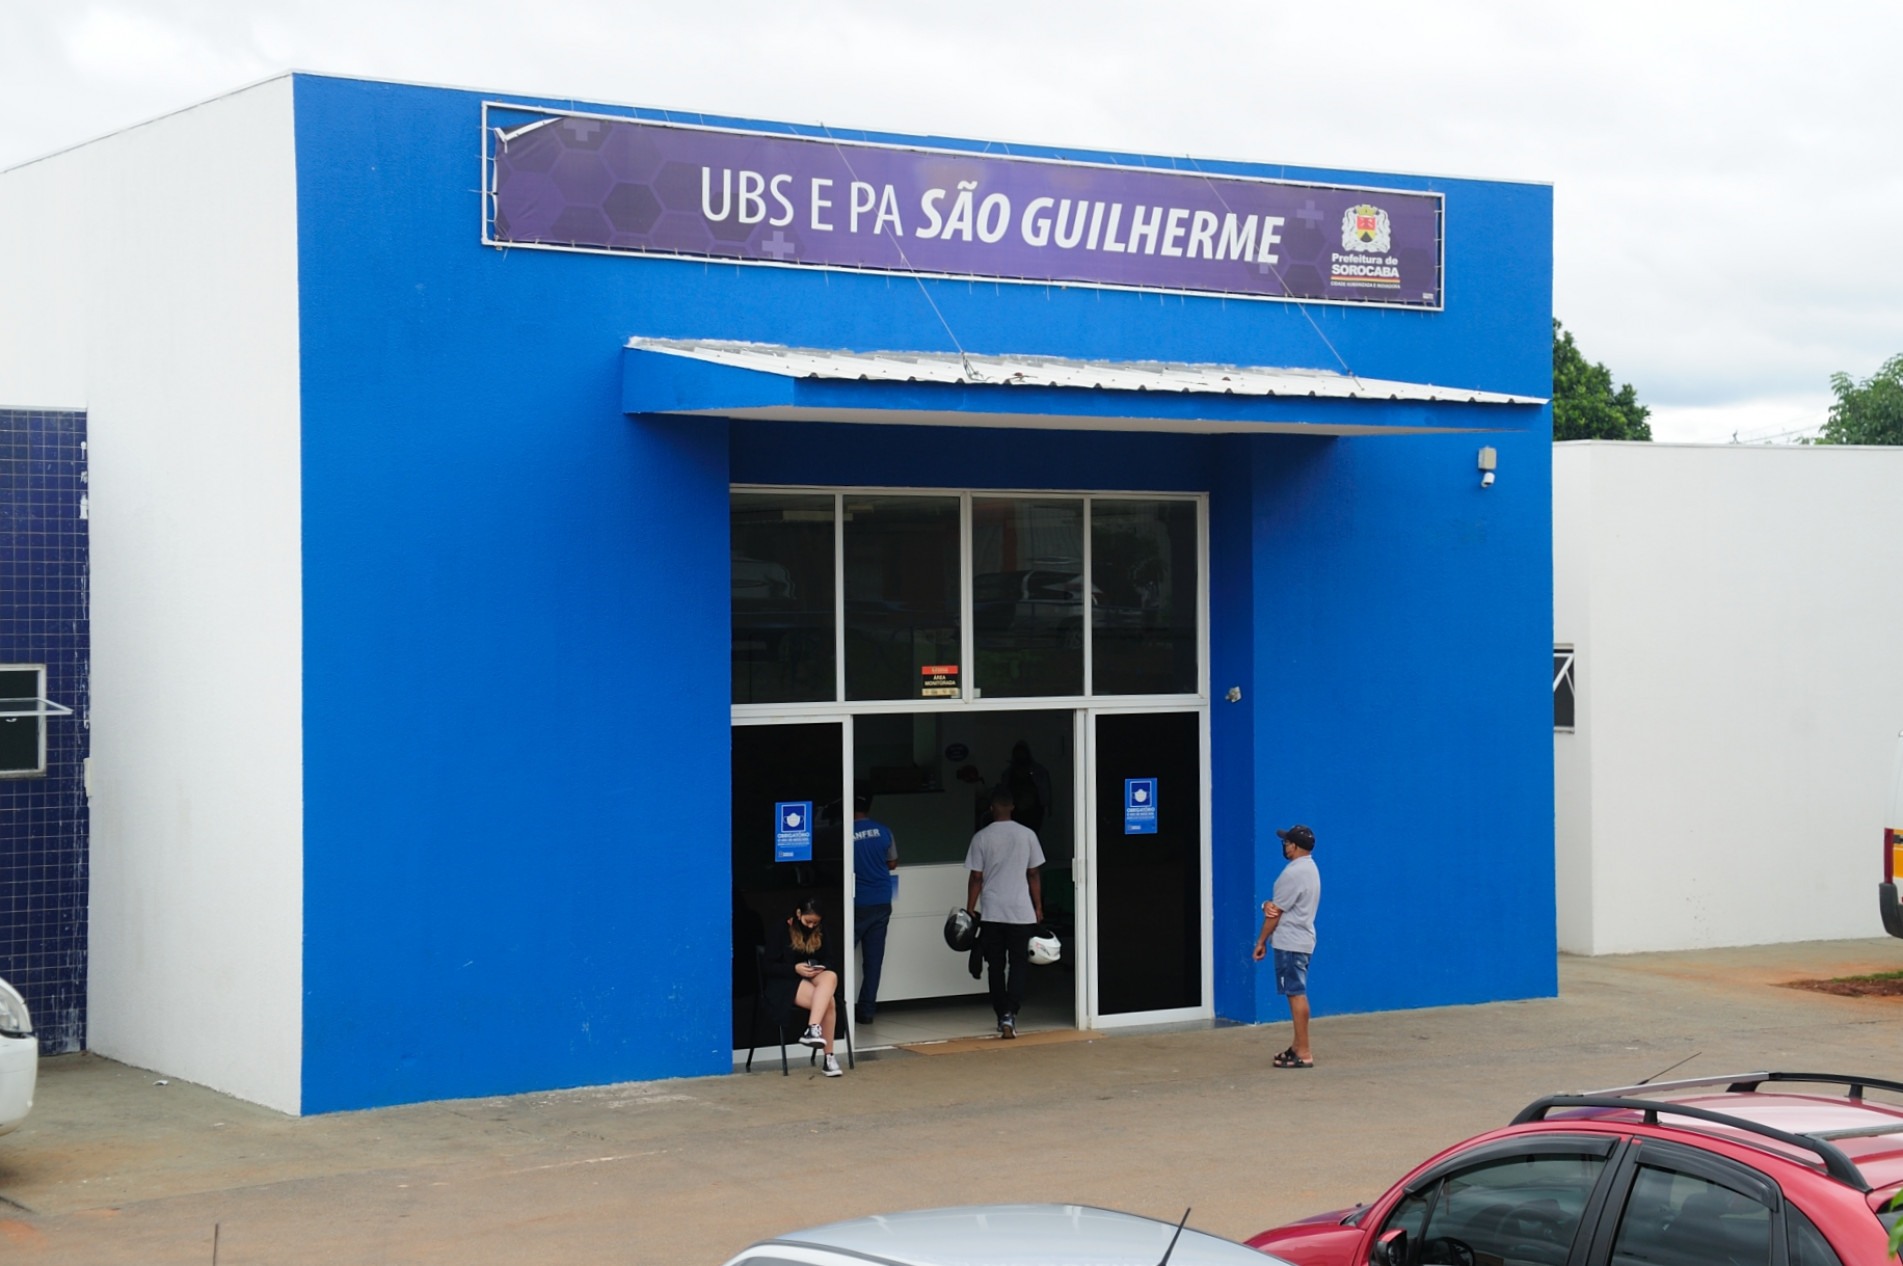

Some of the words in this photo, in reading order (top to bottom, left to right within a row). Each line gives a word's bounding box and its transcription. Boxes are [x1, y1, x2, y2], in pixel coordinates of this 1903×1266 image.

[701, 165, 795, 228] UBS
[811, 177, 834, 232] E
[849, 181, 904, 238] PA
[915, 179, 1012, 245] SÃO
[1020, 195, 1287, 265] GUILHERME
[1331, 252, 1383, 265] Prefeitura
[1385, 255, 1399, 266] de
[1331, 264, 1400, 278] SOROCABA
